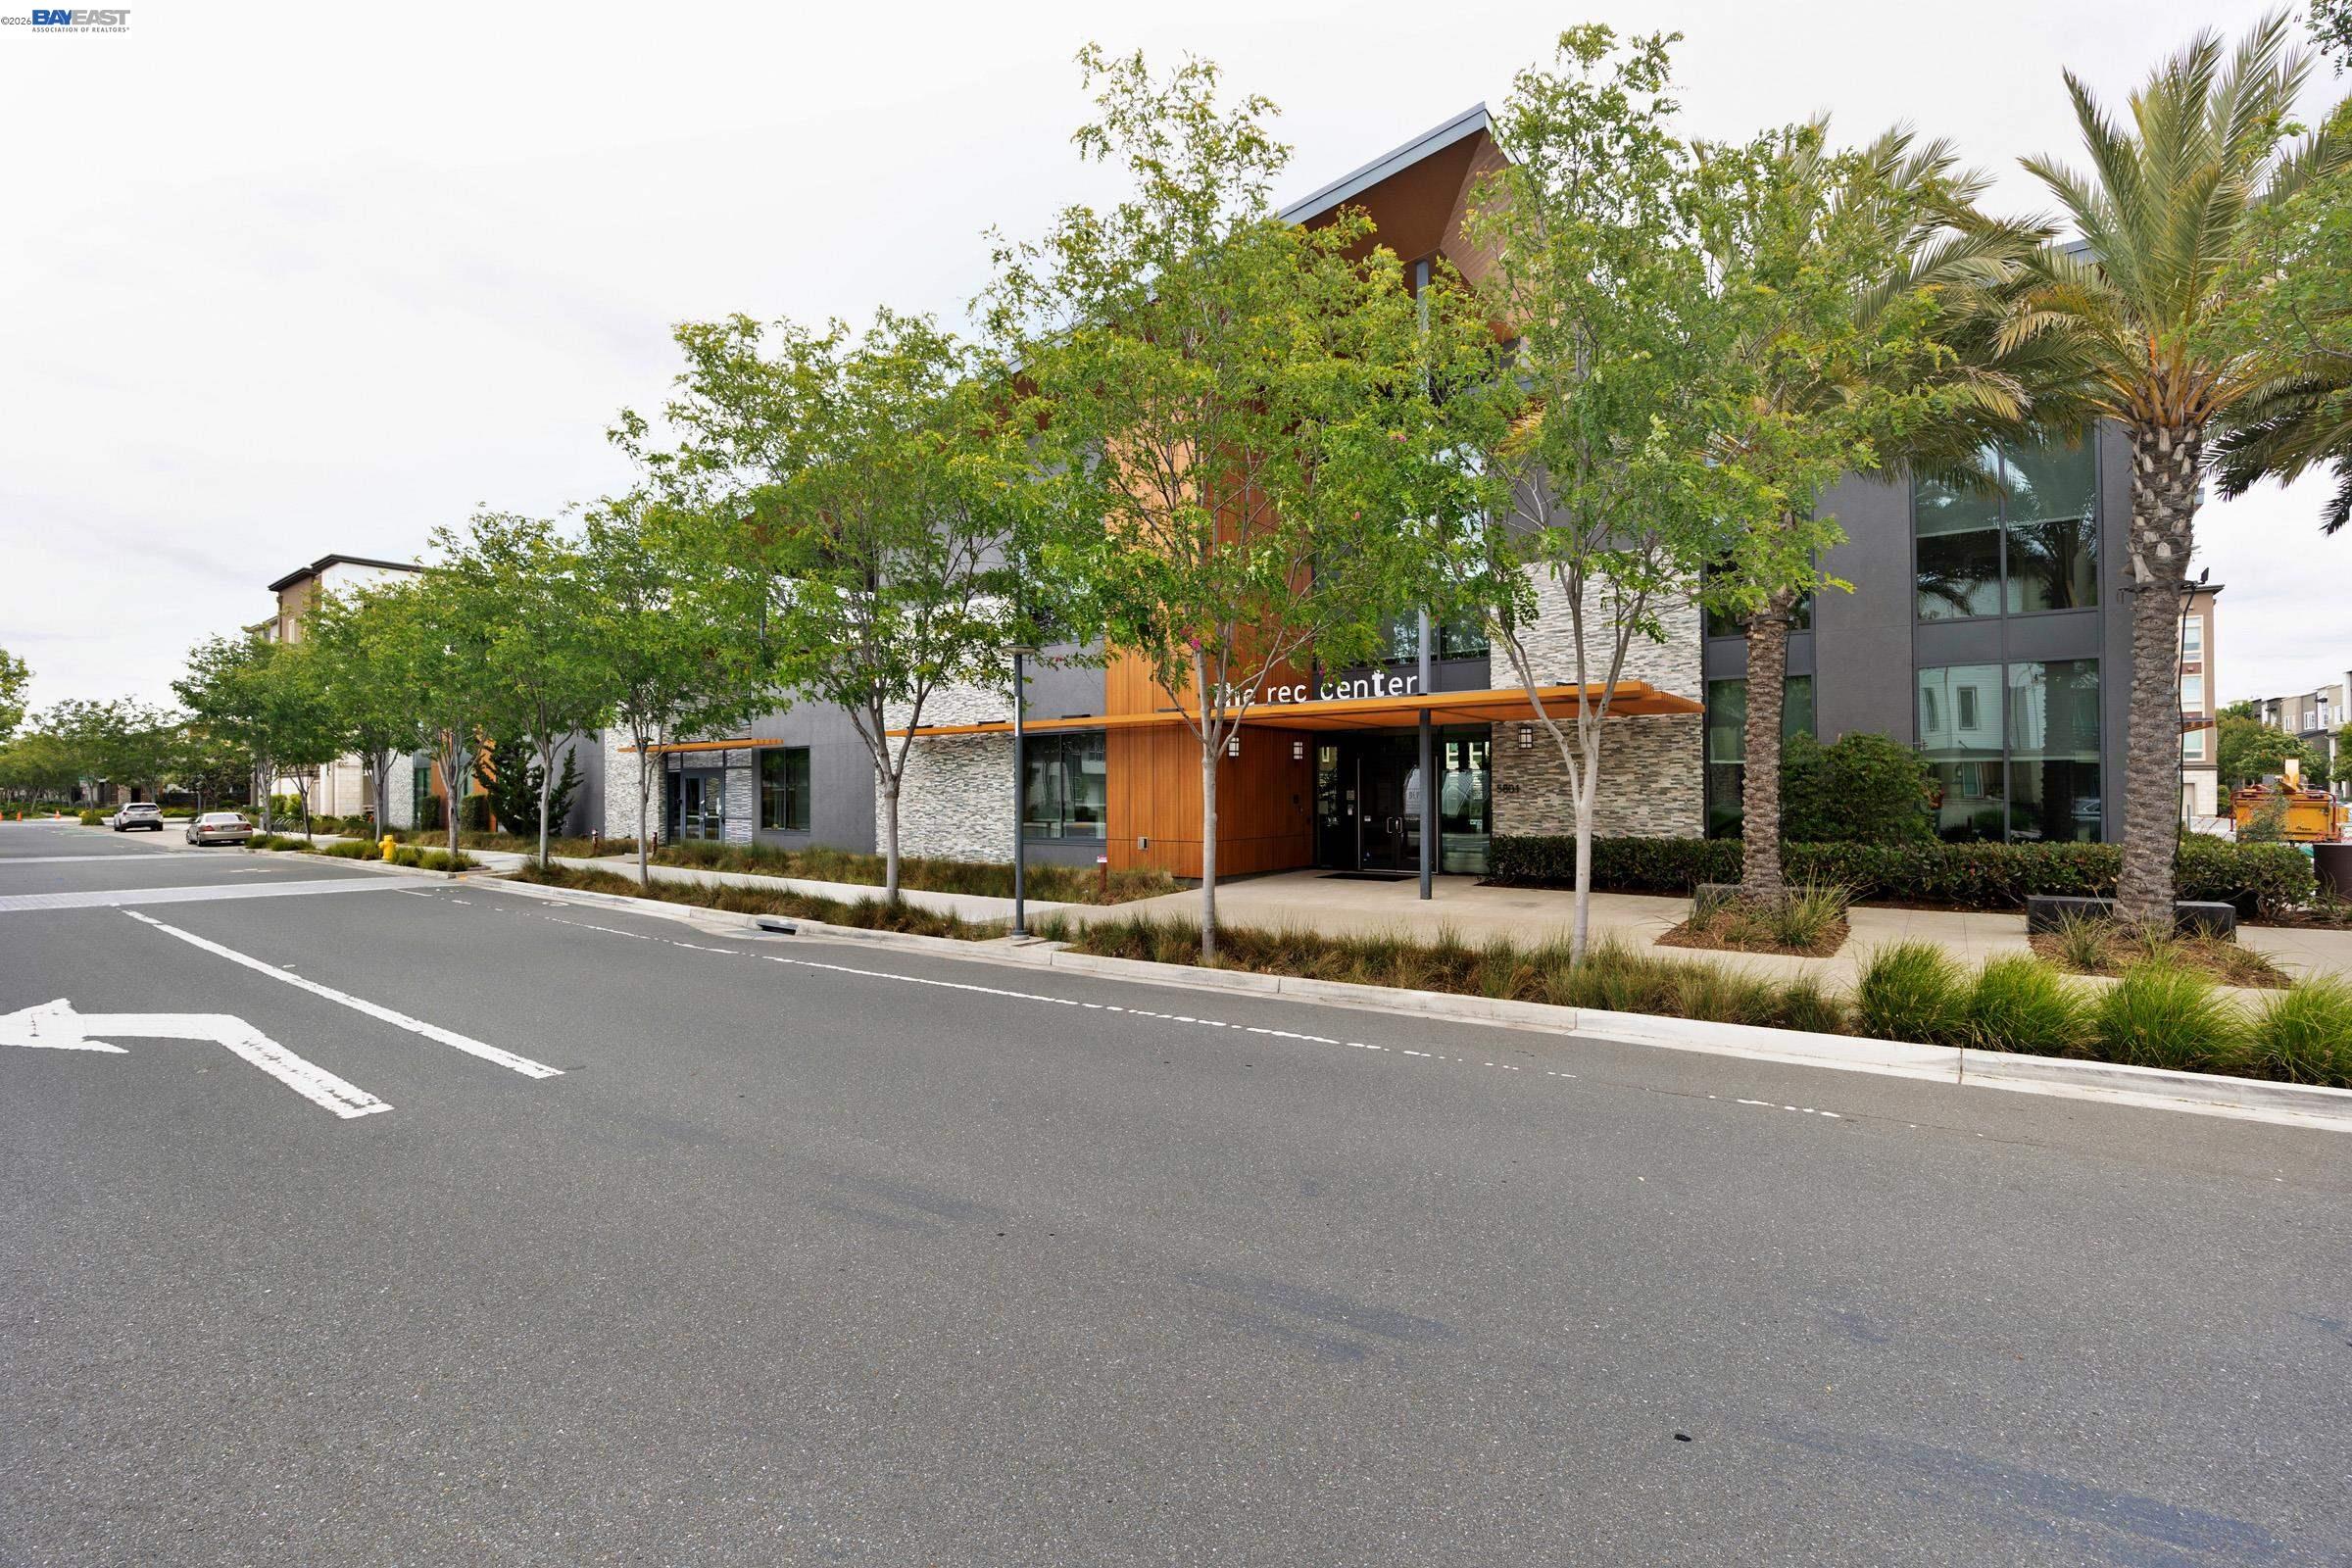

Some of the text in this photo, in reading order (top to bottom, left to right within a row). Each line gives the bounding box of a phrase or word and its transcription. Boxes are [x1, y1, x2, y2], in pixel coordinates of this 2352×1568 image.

[1267, 684, 1307, 704] rec
[1320, 669, 1418, 701] center
[1497, 784, 1520, 793] 5801
